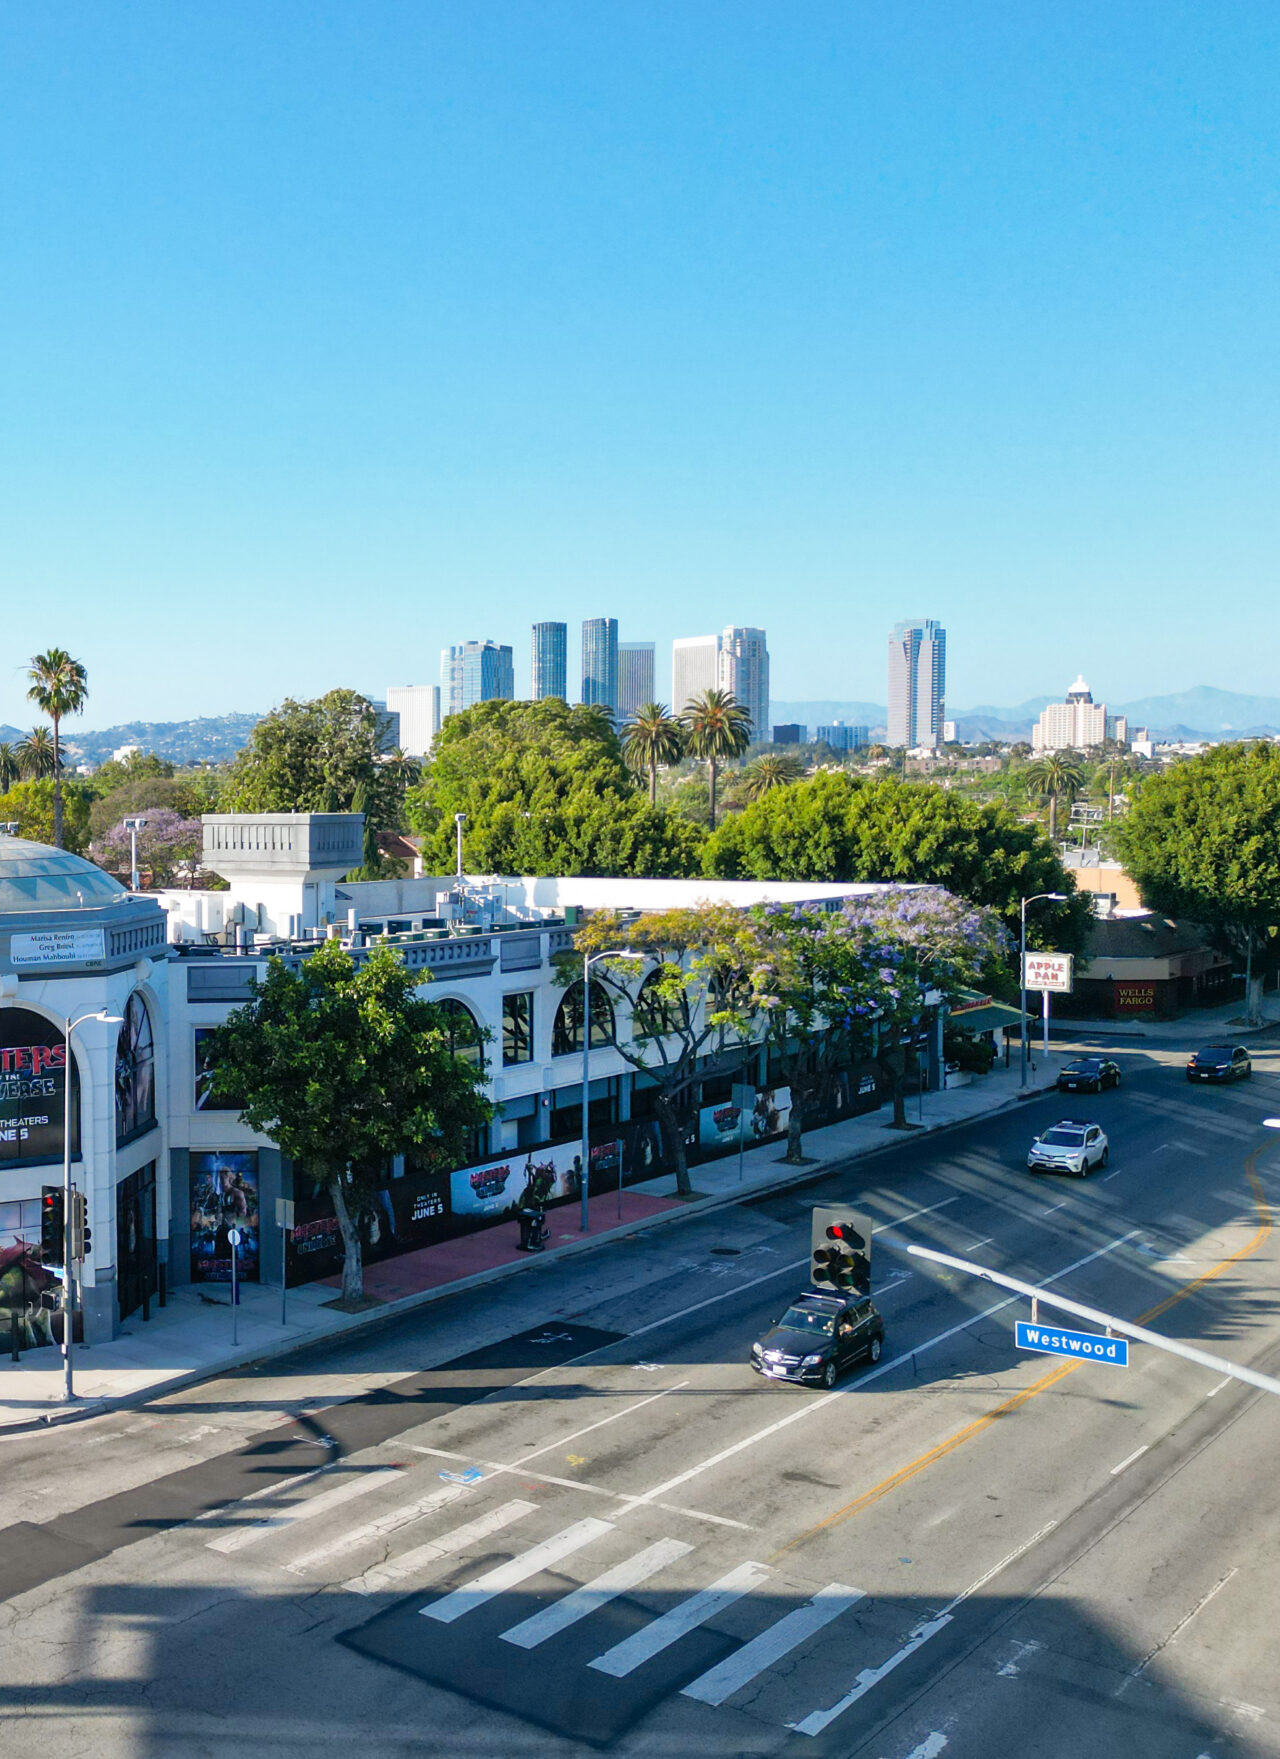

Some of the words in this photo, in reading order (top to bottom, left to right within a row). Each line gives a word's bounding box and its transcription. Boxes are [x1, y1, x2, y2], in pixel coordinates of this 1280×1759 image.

[1028, 961, 1065, 972] APPLE
[1034, 972, 1059, 981] PAN
[0, 1116, 49, 1128] THEATERS
[20, 1128, 28, 1140] 5
[411, 1206, 435, 1220] JUNE
[437, 1203, 443, 1214] 5
[1026, 1329, 1116, 1357] Westwood
